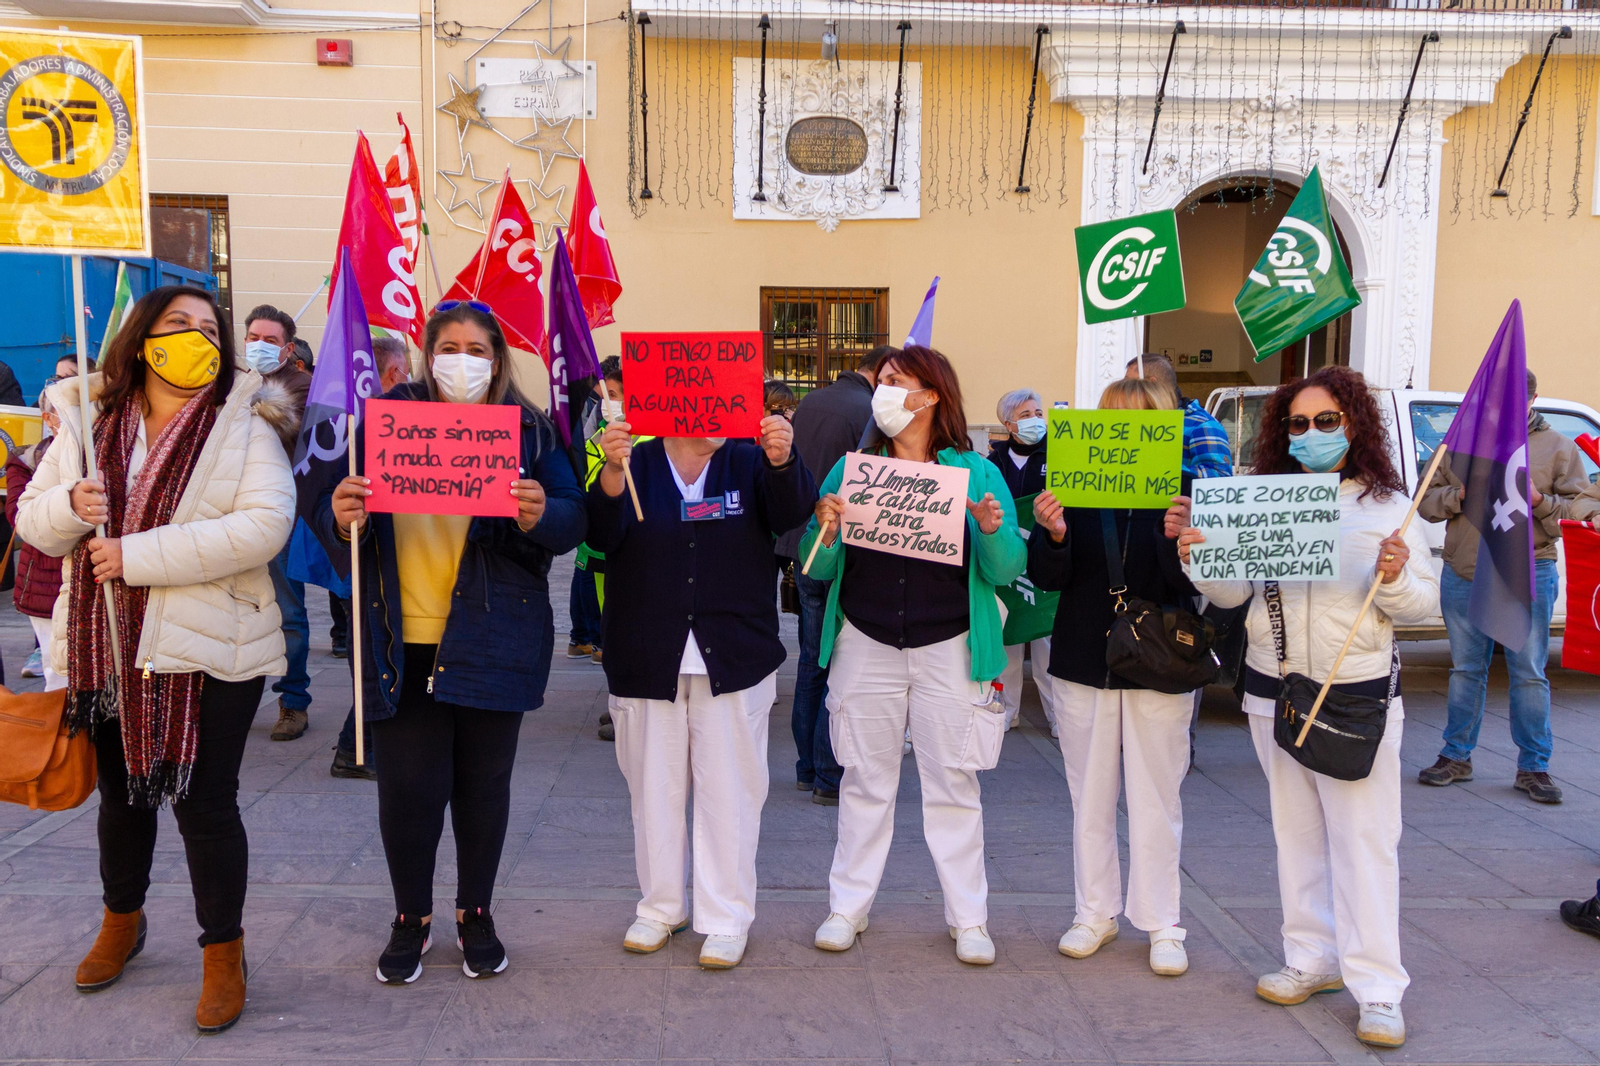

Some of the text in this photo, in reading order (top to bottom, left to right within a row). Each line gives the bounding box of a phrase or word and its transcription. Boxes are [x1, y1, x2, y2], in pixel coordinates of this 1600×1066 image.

[531, 85, 543, 93] DE
[66, 61, 130, 150] ADMINISTRACIÓN
[90, 152, 124, 184] LOCAL
[45, 180, 87, 192] MOTRIL
[1102, 246, 1167, 284] CSIF
[1266, 231, 1316, 293] CSIF
[625, 340, 756, 362] NO TENGO EDAD
[665, 366, 714, 387] PARA
[628, 394, 747, 414] AGUANTAR
[378, 413, 512, 446] 3 años sin ropa
[674, 413, 721, 434] MÁS
[1052, 419, 1176, 442] YA NO SE NOS
[376, 443, 517, 470] 1 muda con una
[1088, 446, 1141, 465] PUEDE
[1050, 468, 1180, 496] EXPRIMIR MÁS
[849, 487, 874, 505] de
[1194, 485, 1338, 505] DESDE 2018 CON
[1192, 513, 1223, 529] UNA
[1227, 512, 1269, 529] MUDA
[1271, 511, 1291, 525] DE
[845, 521, 900, 547] Todos
[911, 530, 958, 557] Todas
[1237, 528, 1293, 544] ES UNA
[1191, 540, 1335, 565] VERGÜENZA Y EN
[1201, 555, 1334, 579] UNA PANDEMIA
